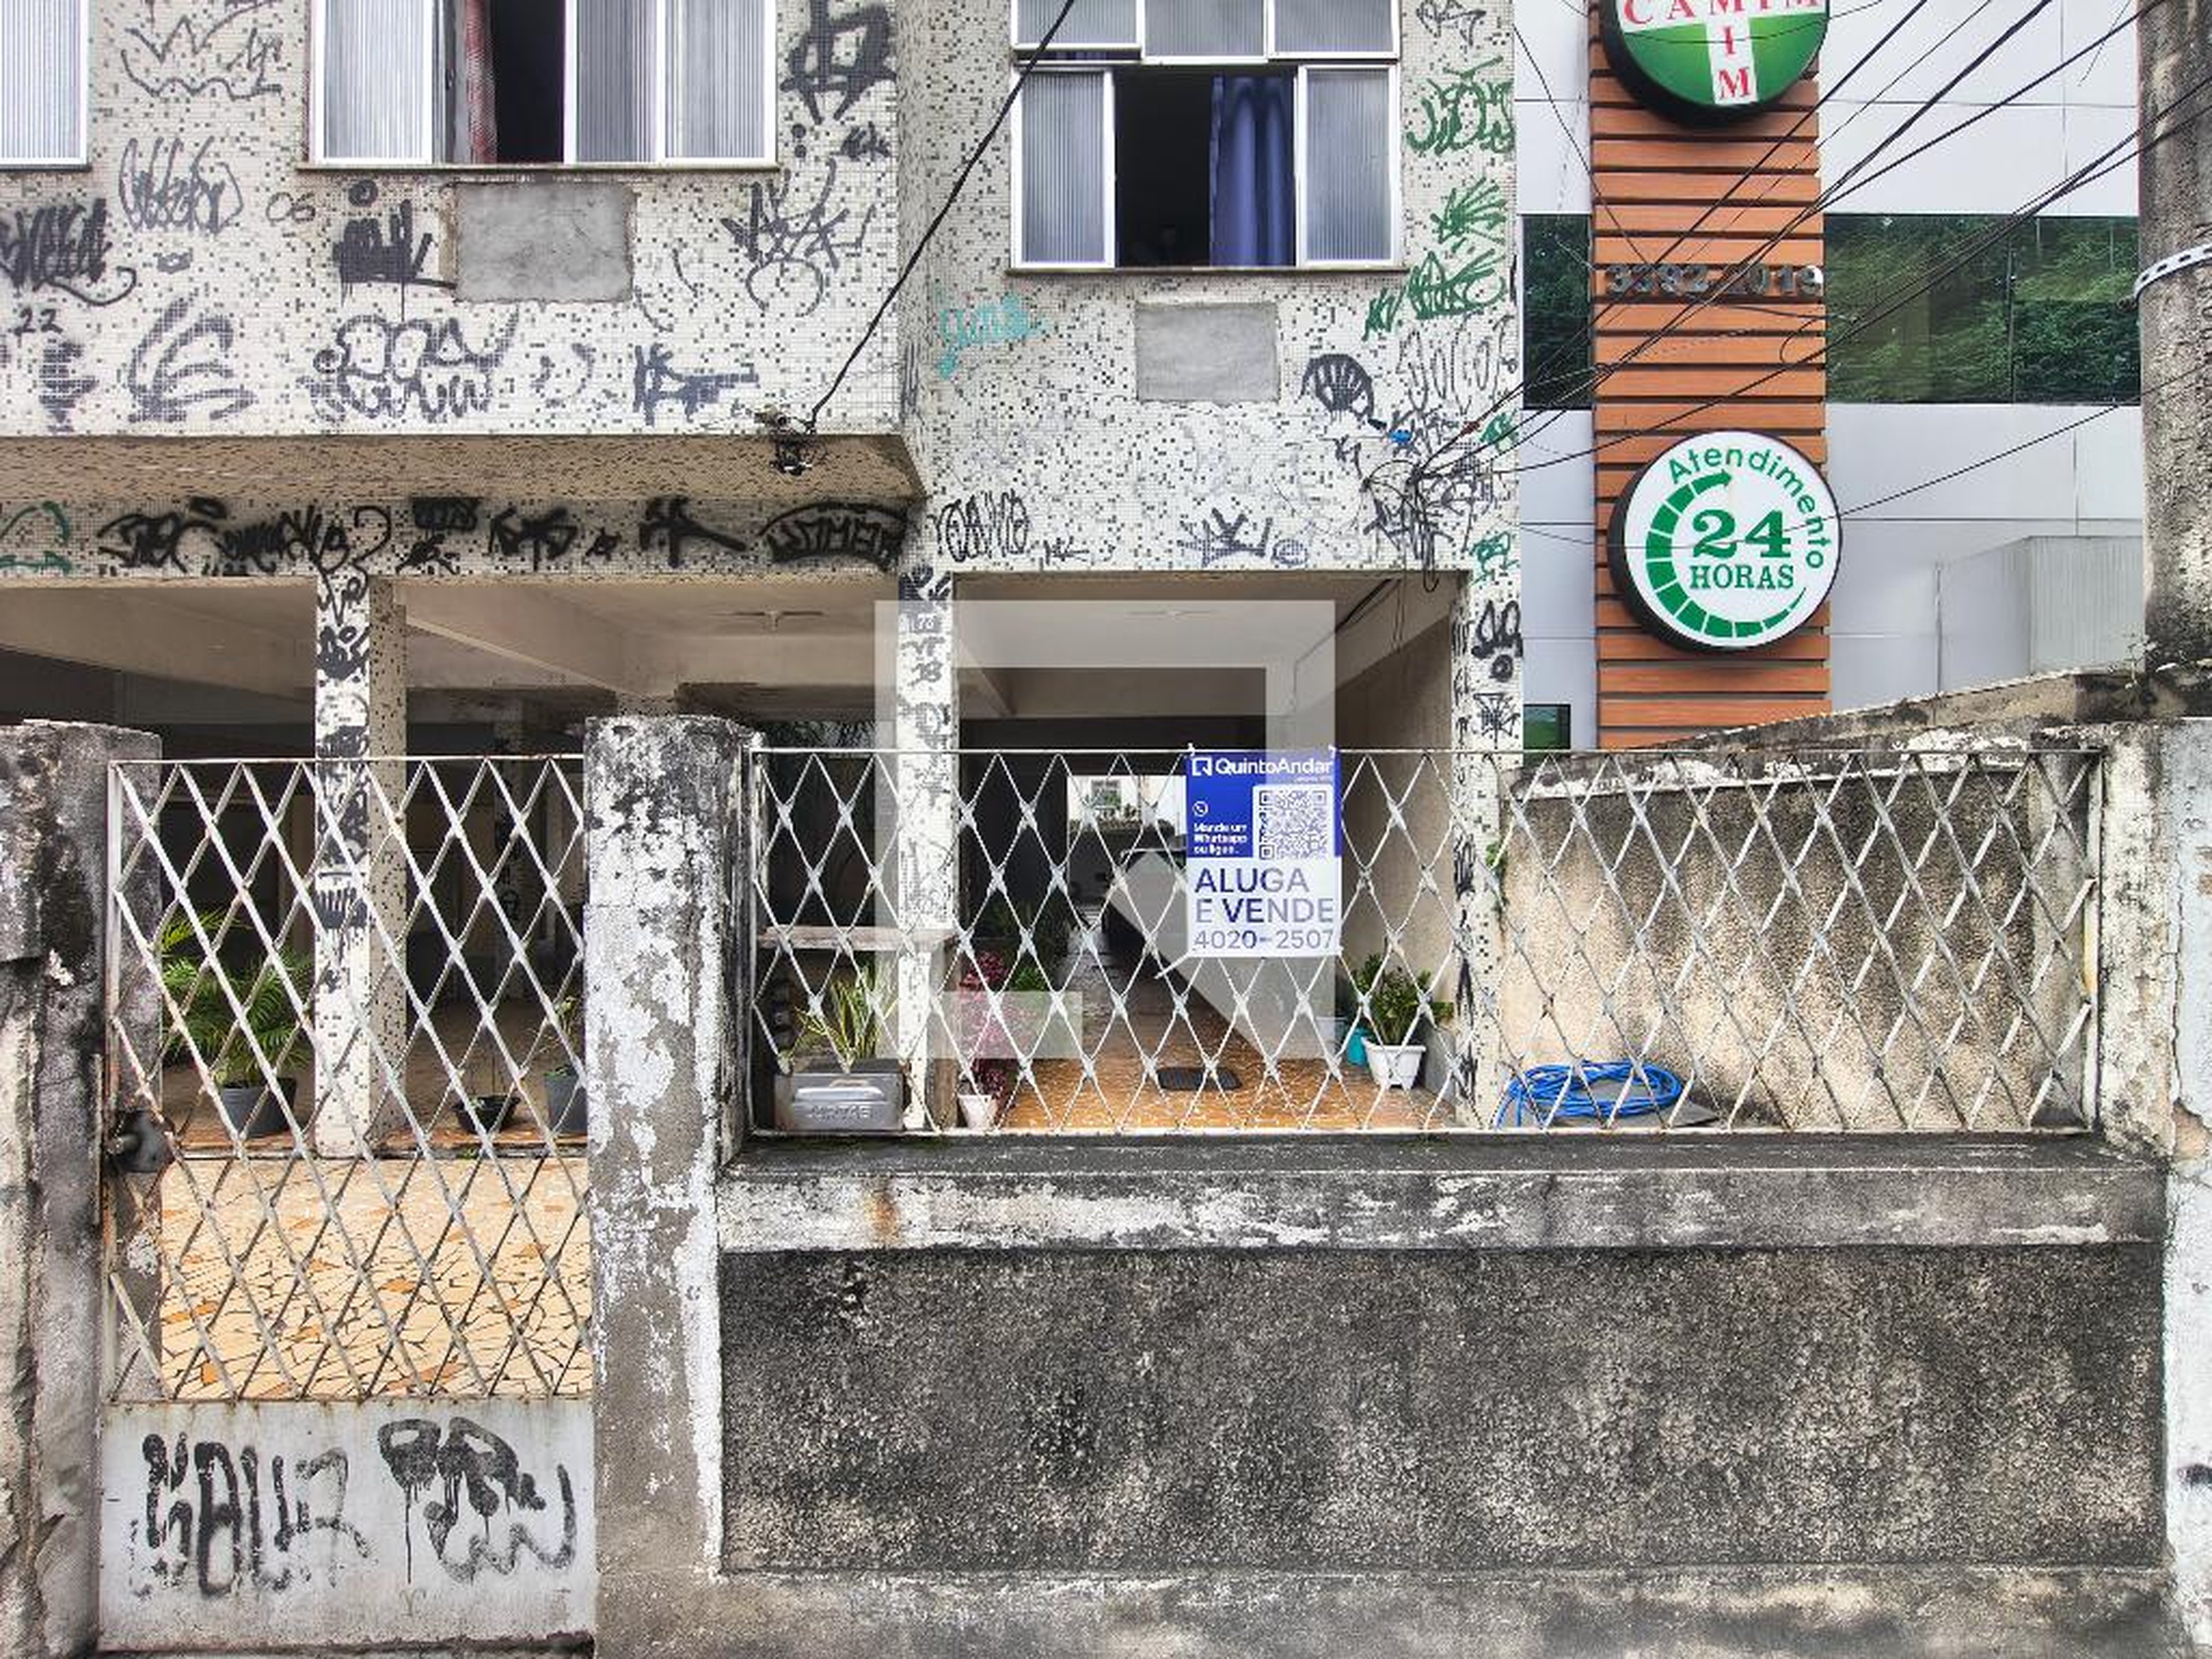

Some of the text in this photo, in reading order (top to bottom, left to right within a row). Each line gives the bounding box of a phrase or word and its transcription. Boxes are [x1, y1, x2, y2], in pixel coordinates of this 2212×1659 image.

[1668, 447, 1831, 569] Atendimento
[1692, 509, 1791, 558] 24
[1690, 565, 1794, 589] HORAS
[1215, 757, 1332, 775] QuintoAndar
[1194, 868, 1310, 893] ALUGA
[1196, 898, 1334, 923] E VENDE
